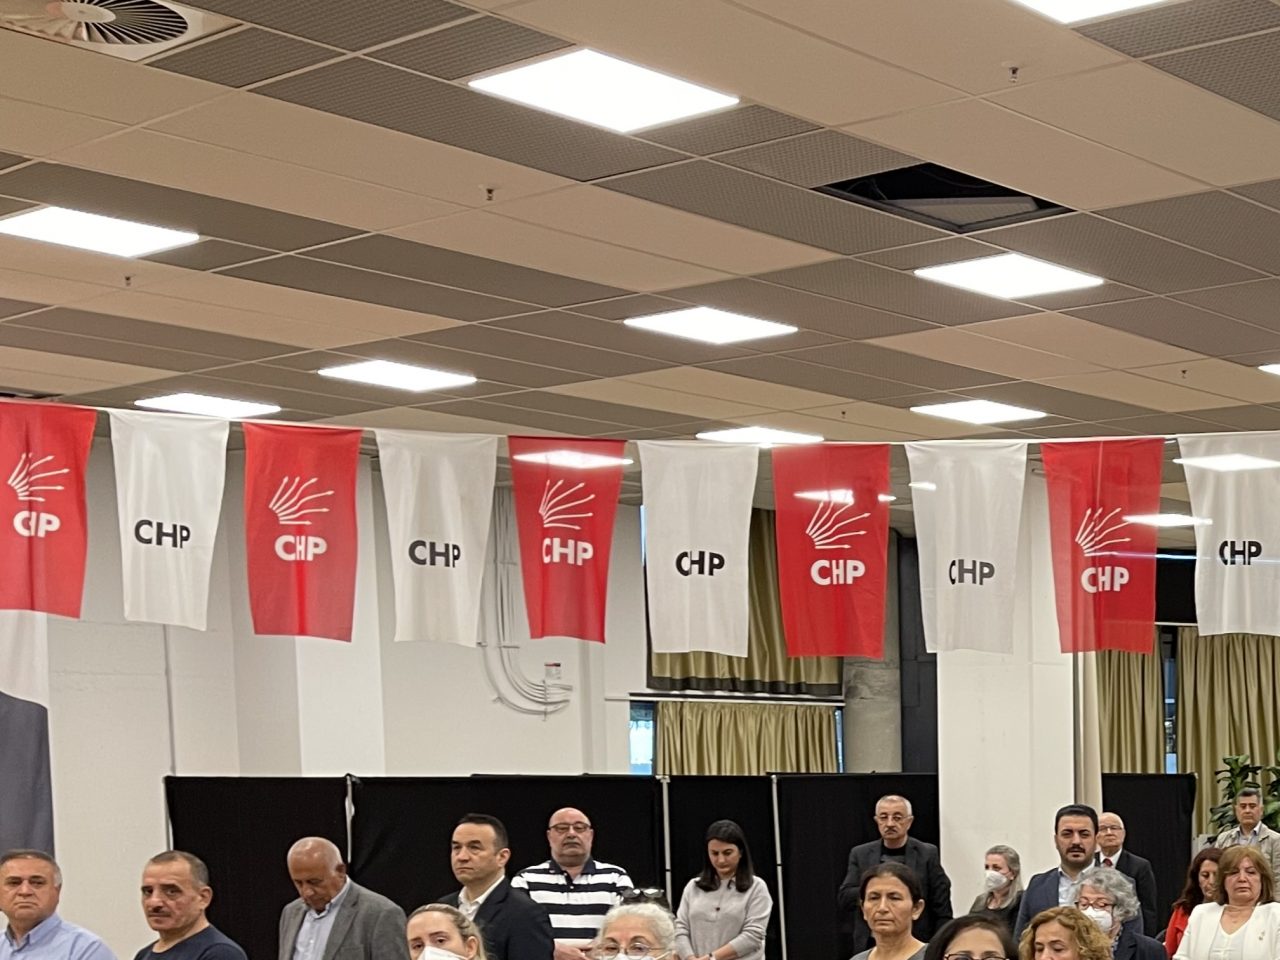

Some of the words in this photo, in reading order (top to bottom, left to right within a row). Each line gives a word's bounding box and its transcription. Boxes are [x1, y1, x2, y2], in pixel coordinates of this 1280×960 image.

[134, 520, 190, 548] CHP
[275, 535, 327, 561] CHP
[408, 540, 461, 567] CHP
[543, 537, 594, 565] CHP
[1219, 541, 1262, 566] CHP
[675, 551, 725, 576] CHP
[811, 560, 865, 585] CHP
[949, 559, 995, 585] CHP
[1081, 566, 1129, 592] CHP
